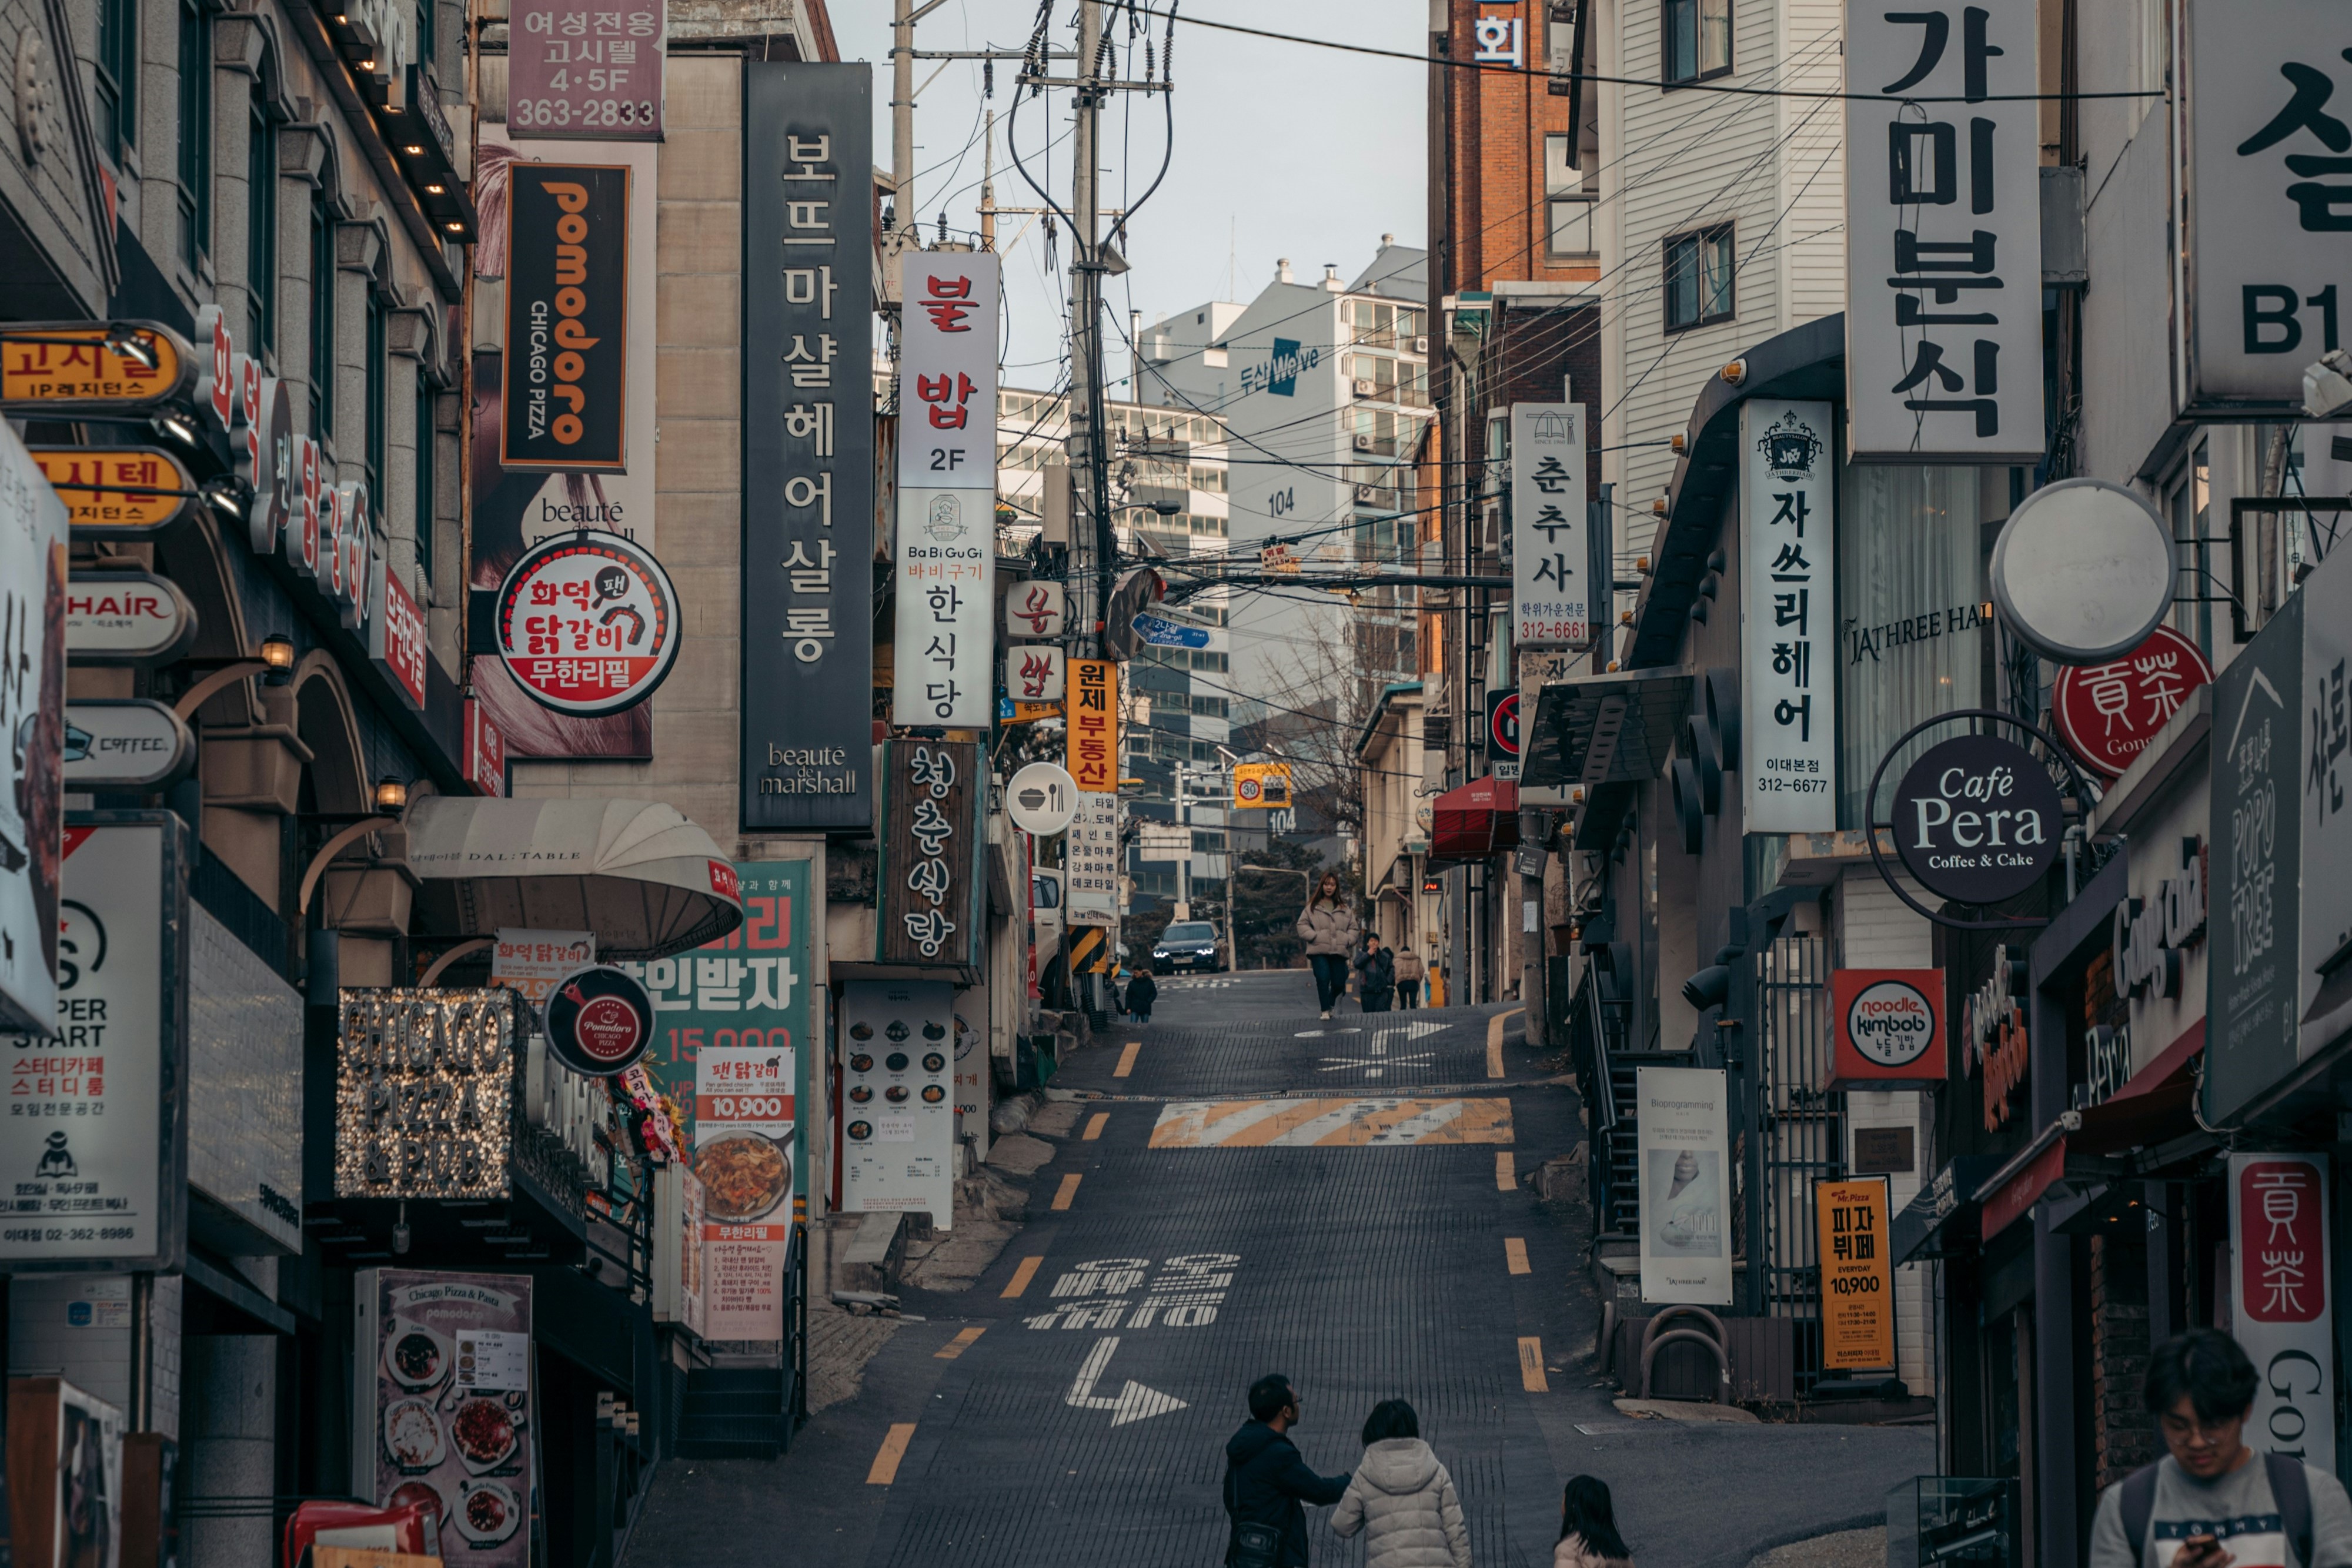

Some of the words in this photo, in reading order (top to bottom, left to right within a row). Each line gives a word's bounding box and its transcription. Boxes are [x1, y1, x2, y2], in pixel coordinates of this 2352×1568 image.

[525, 11, 656, 36] 여성전용
[543, 40, 637, 63] 고시텔
[1475, 16, 1523, 68] 회
[516, 99, 654, 126] 363-2833
[1882, 5, 2004, 437] 가미분식
[540, 181, 601, 445] pomodoro
[2242, 285, 2339, 354] B1
[529, 300, 547, 383] CHICAGO
[917, 274, 980, 430] 불밥
[30, 382, 145, 396] IP레지던스
[1241, 362, 1268, 396] 두산
[528, 388, 546, 440] PIZZA
[930, 448, 965, 471] 2F
[36, 461, 158, 503] 시텔
[68, 506, 144, 519] 지던스
[542, 499, 623, 522] beauté
[1267, 487, 1294, 518] 104
[1531, 456, 1573, 593] 춘추사
[1266, 546, 1285, 557] 위험
[908, 562, 983, 581] 바비구기
[530, 579, 592, 611] 화덕
[603, 575, 626, 596] 팬
[68, 593, 172, 618] HAIR
[1521, 603, 1585, 618] 학위가운전문
[1769, 490, 1812, 742] 자쓰리헤어
[387, 581, 425, 693] 무한리필
[526, 614, 623, 654] 닭갈비
[1522, 622, 1586, 639] 312-6661
[1842, 611, 1942, 666] JATHREE
[925, 584, 963, 718] 한식당
[530, 660, 630, 688] 무한리필
[1020, 650, 1054, 698] 밥
[769, 743, 846, 766] beauté
[1766, 758, 1819, 773] 이대본점
[760, 769, 857, 795] marshall
[798, 765, 813, 778] de
[1243, 785, 1256, 795] 30
[1758, 778, 1827, 794] 312-6677
[1940, 765, 2014, 804] Café
[1269, 807, 1297, 838] 104
[1910, 796, 2047, 850] Pera
[2232, 779, 2276, 891] POPO
[1072, 862, 1114, 874] 강화마루
[1929, 855, 1976, 870] Coffee
[1980, 854, 1993, 868] &
[1997, 853, 2034, 867] Cake
[769, 878, 791, 891] 함께
[1072, 878, 1114, 890] 데코타일
[2230, 862, 2274, 976] TREE
[498, 942, 532, 962] 화덕
[536, 942, 581, 962] 닭갈비
[58, 999, 106, 1021] PER
[1862, 997, 1925, 1017] noodle
[342, 1001, 503, 1069] CHICAGO
[584, 1021, 632, 1033] Pomodoro
[1857, 1015, 1926, 1037] kimbob
[1876, 1038, 1892, 1057] 누들
[1895, 1035, 1915, 1051] 김밥
[13, 1057, 103, 1075] 스터디카페
[711, 1061, 731, 1081] 팬
[734, 1061, 778, 1080] 닭갈비
[11, 1078, 104, 1096] 스터디룸
[10, 1102, 104, 1118] 모임전문공간
[365, 1082, 482, 1125] PIZZA
[712, 1096, 781, 1121] 10,900
[1651, 1098, 1713, 1111] Bioprogramming
[362, 1138, 386, 1181] &
[400, 1138, 481, 1181] PUB
[1838, 1193, 1869, 1203] Mr.Pizza
[1832, 1206, 1874, 1233] 피자
[5, 1229, 42, 1242] 이대점
[719, 1226, 767, 1240] 무한리필
[2252, 1171, 2308, 1314] 貢茶
[1833, 1234, 1875, 1261] 뷔페
[1838, 1265, 1871, 1273] EVERYDAY
[409, 1287, 443, 1302] Chicago
[444, 1285, 467, 1299] Pizza
[478, 1292, 500, 1308] Pasta
[1830, 1276, 1879, 1296] 10,900
[427, 1308, 484, 1321] pomodoro
